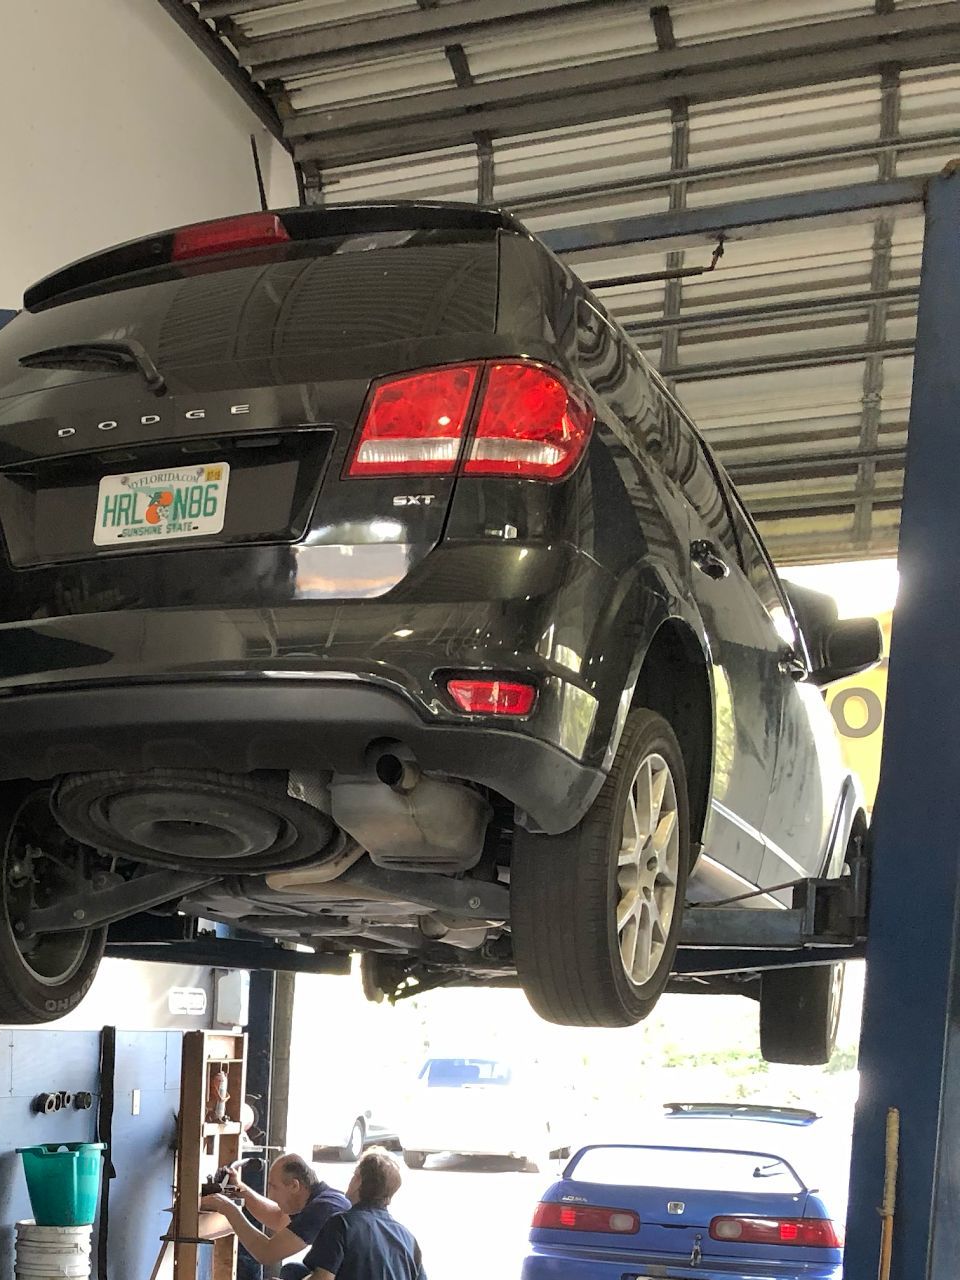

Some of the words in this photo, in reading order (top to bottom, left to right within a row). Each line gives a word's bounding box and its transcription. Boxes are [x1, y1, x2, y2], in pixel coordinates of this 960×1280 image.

[57, 404, 250, 438] DODGE
[102, 493, 143, 528] HRL
[173, 484, 219, 520] N86
[393, 494, 435, 506] SXT
[121, 525, 162, 538] SUNSHINE
[166, 521, 193, 534] STATE
